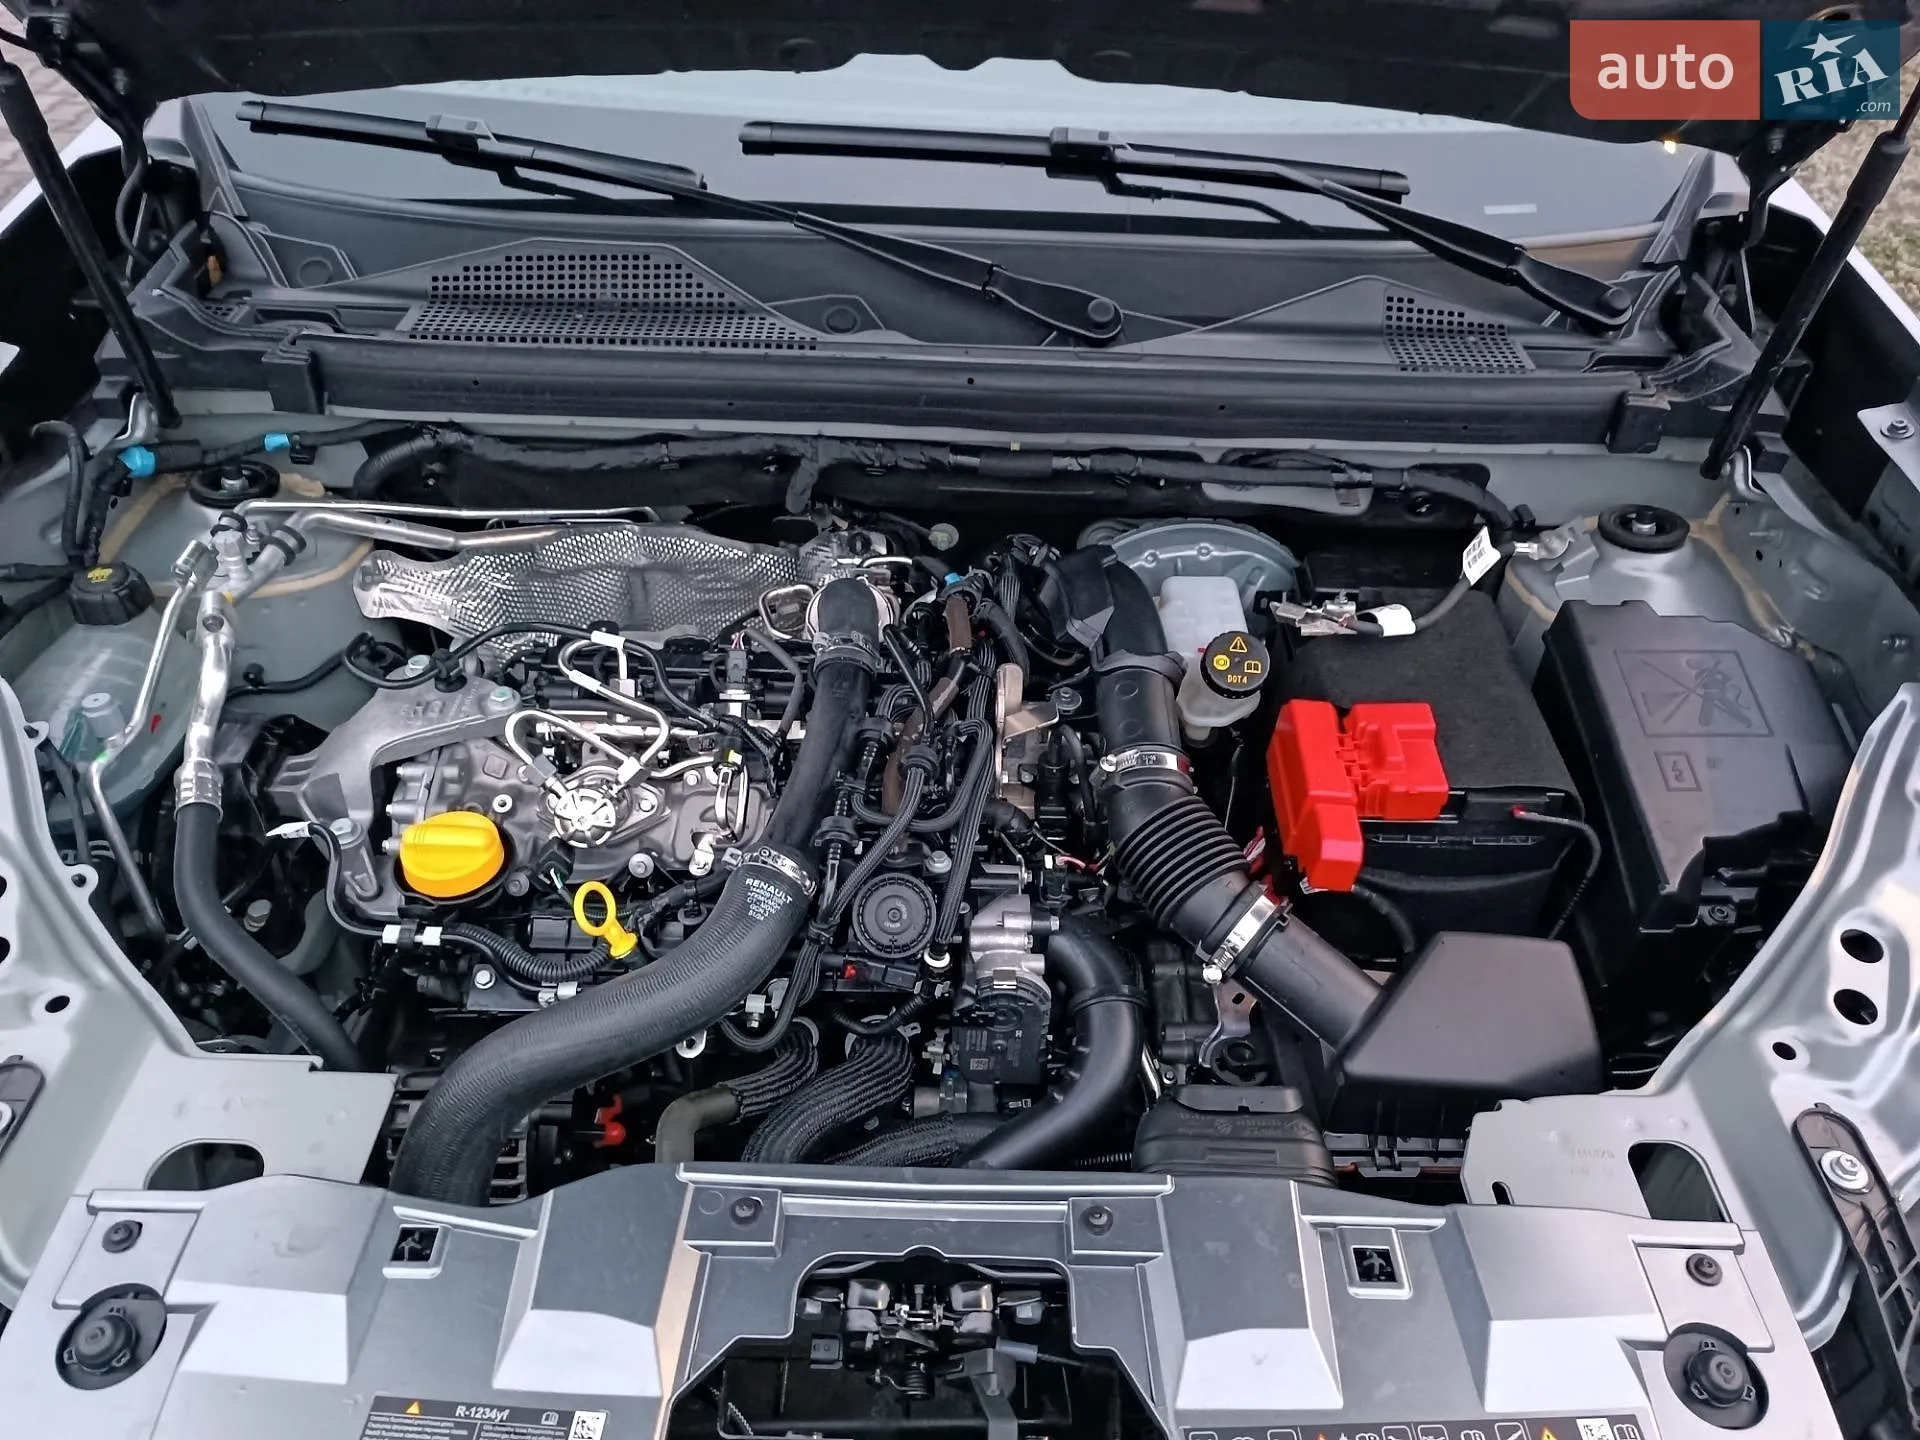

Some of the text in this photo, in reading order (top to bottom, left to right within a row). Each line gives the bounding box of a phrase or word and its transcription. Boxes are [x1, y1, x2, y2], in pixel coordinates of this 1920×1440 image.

[1227, 674, 1248, 684] DOT 4
[745, 878, 793, 904] RENAULT
[455, 1405, 510, 1424] R-1234yf
